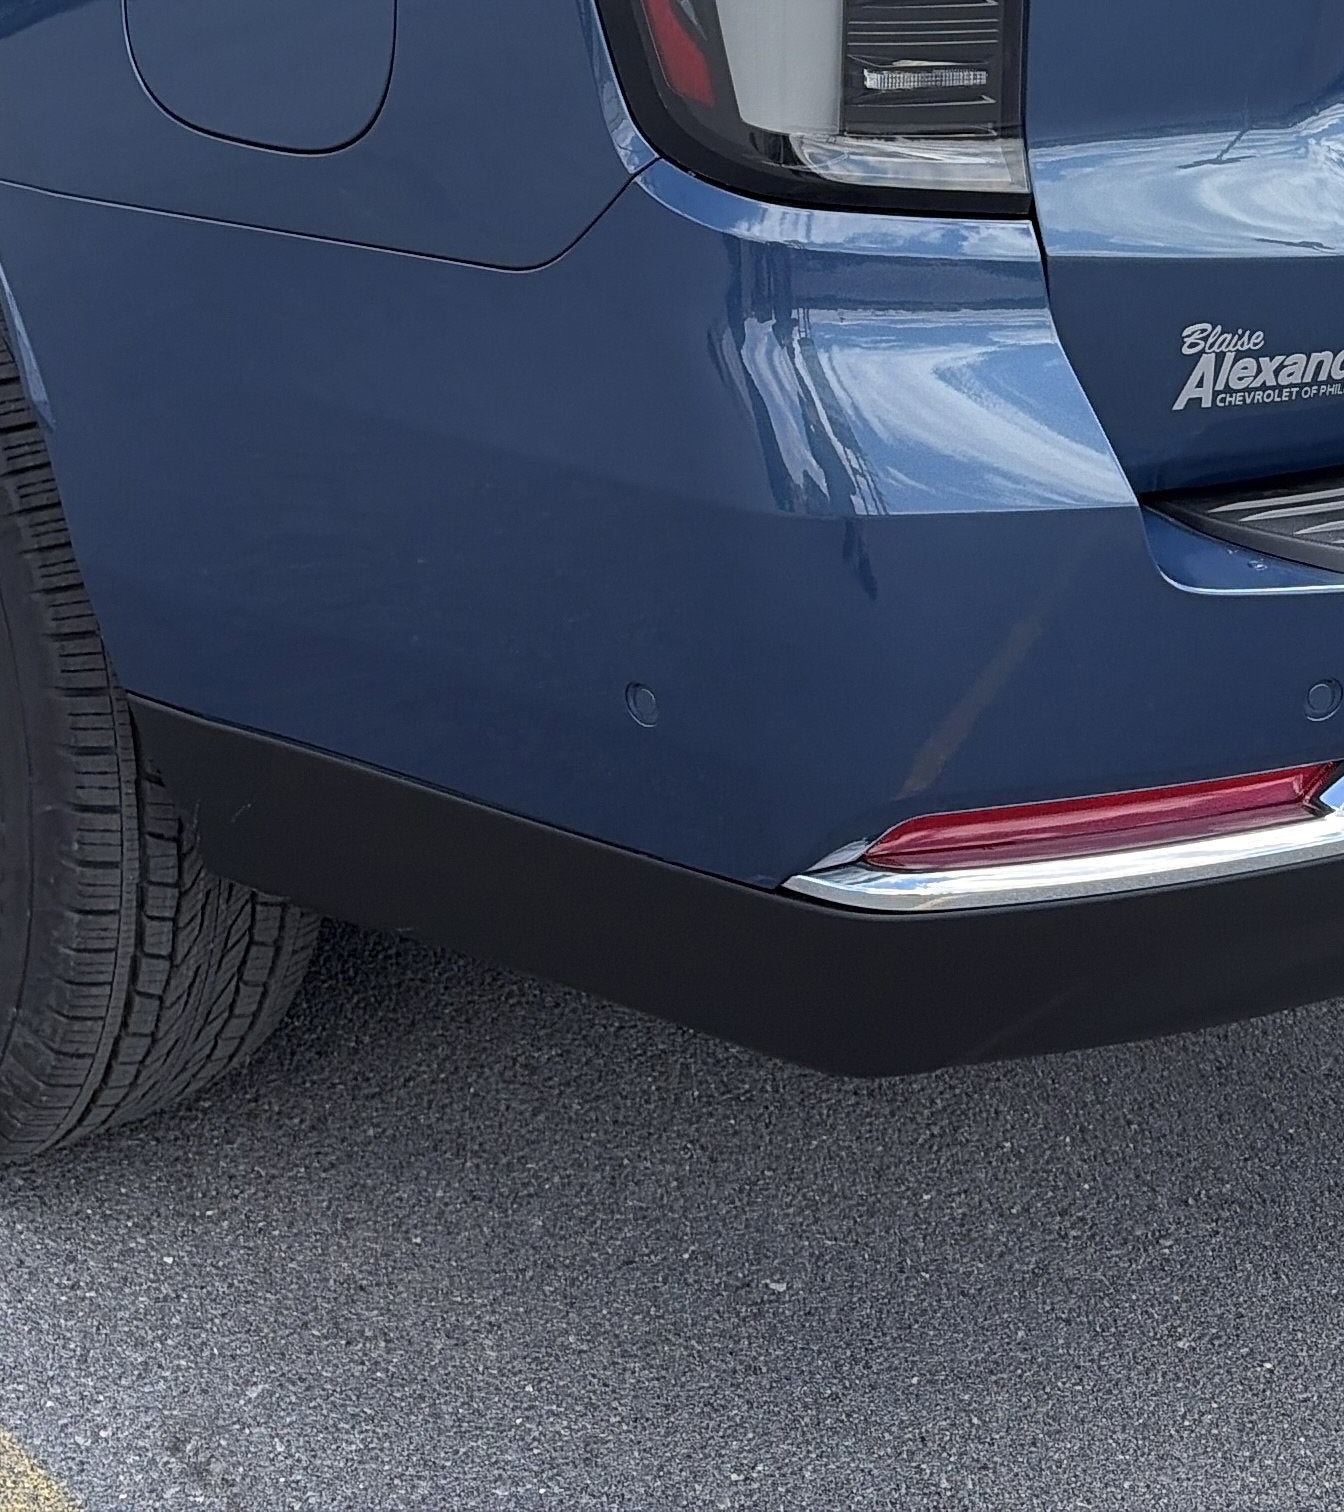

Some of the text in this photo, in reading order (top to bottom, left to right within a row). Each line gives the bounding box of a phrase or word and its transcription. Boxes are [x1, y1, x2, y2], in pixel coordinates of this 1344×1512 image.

[1181, 322, 1265, 355] Blaise
[1216, 387, 1300, 407] CHEVROLET
[1301, 386, 1318, 399] OF
